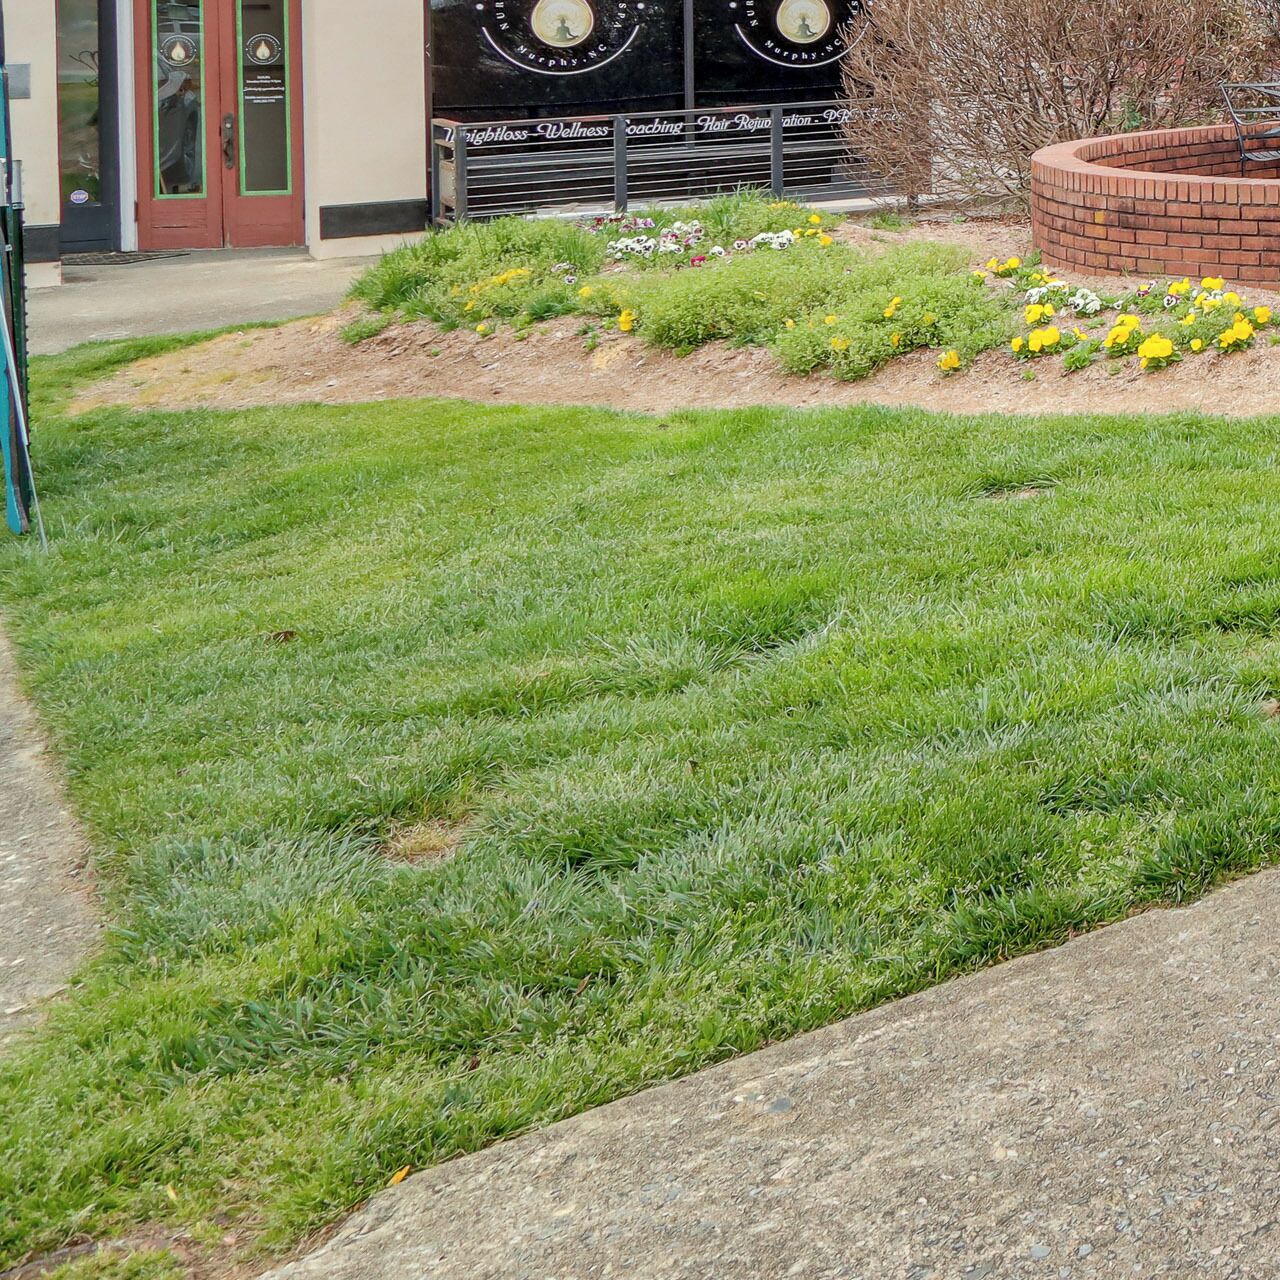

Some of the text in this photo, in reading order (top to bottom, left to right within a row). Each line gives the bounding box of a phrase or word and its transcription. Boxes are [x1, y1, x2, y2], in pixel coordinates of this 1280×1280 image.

[825, 38, 842, 52] NC
[536, 122, 609, 139] Wellness
[697, 115, 730, 133] Hair
